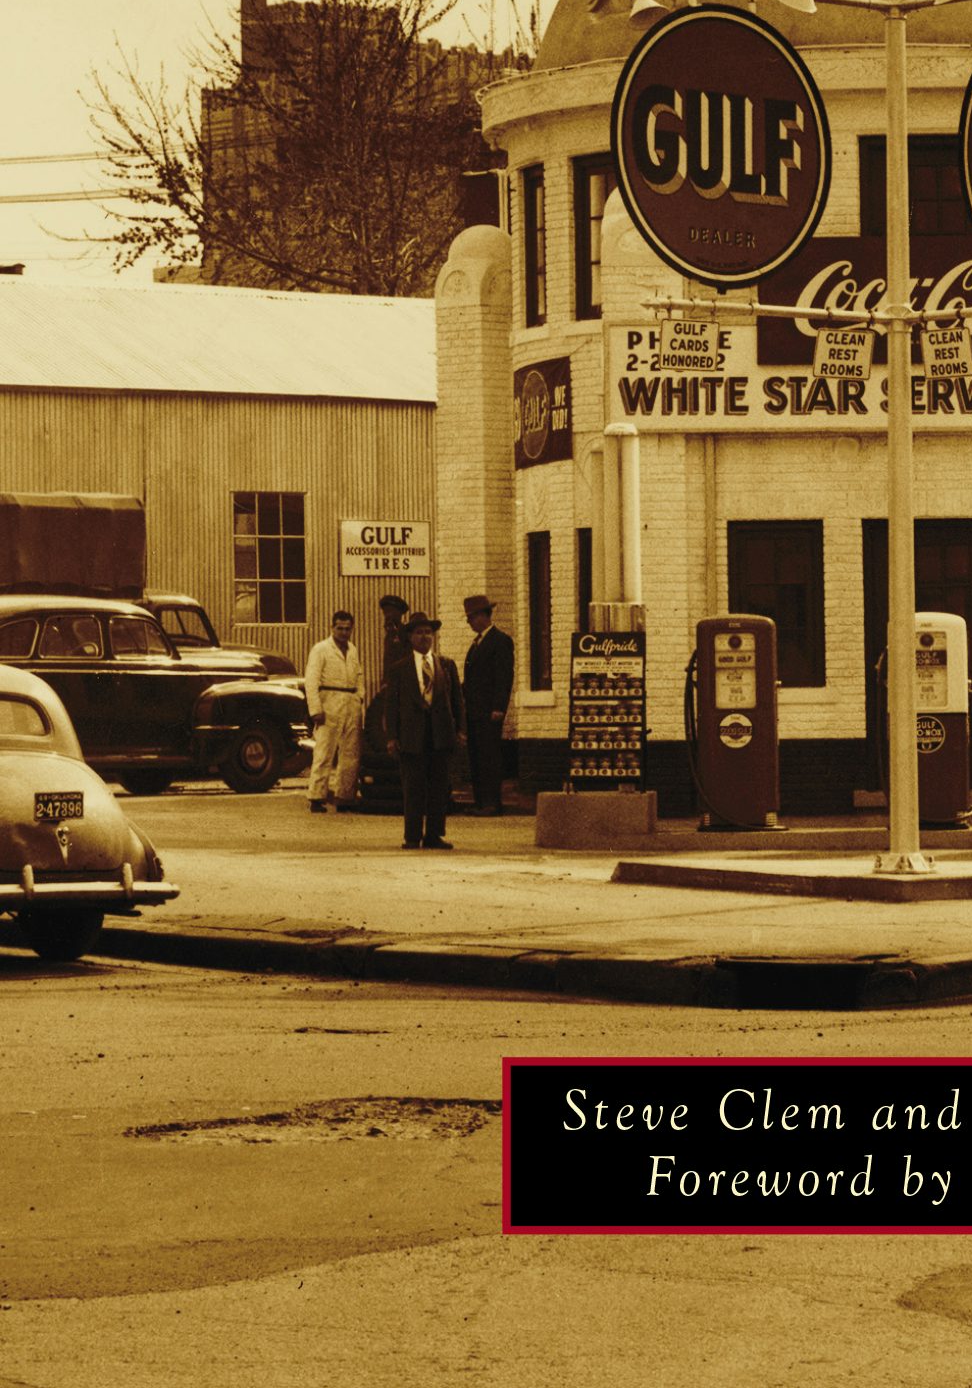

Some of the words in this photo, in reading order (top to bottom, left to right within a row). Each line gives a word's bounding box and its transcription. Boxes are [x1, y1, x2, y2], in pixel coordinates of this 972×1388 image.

[632, 84, 805, 207] GULF
[690, 227, 756, 249] DEALER
[673, 323, 708, 336] GULF
[627, 331, 732, 350] PHE
[825, 332, 866, 347] CLEAN
[928, 330, 963, 345] CLEAN
[669, 338, 709, 352] CARDS
[828, 348, 859, 361] REST
[934, 346, 960, 360] REST
[662, 354, 714, 368] HONORED
[820, 363, 863, 377] ROOMS
[930, 362, 968, 376] ROOMS
[618, 376, 749, 416] WHITE
[762, 376, 869, 416] STAR
[361, 526, 413, 546] GULF
[363, 558, 410, 570] TIRES
[579, 635, 639, 656] Gulfpride
[916, 729, 943, 738] O-NOX
